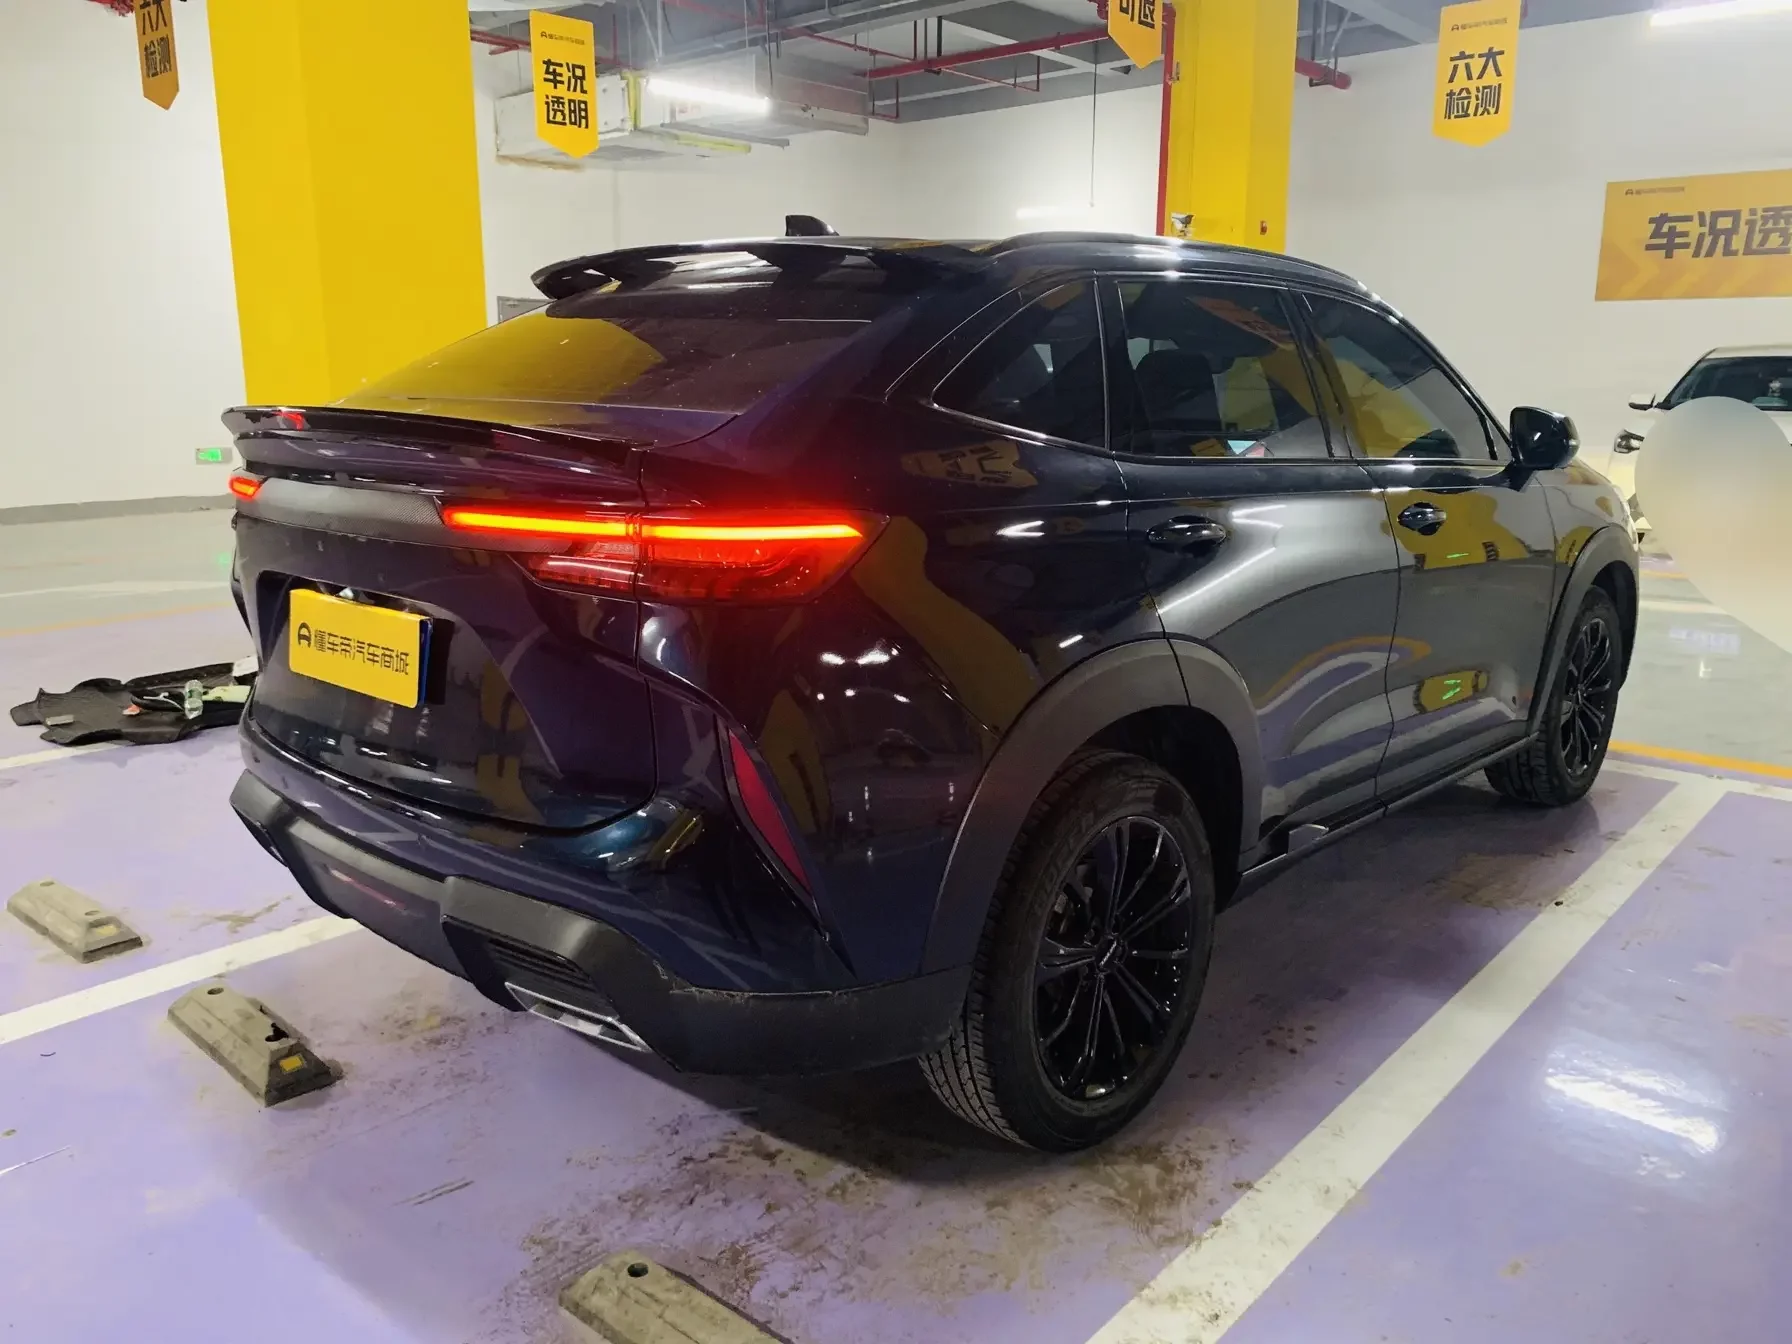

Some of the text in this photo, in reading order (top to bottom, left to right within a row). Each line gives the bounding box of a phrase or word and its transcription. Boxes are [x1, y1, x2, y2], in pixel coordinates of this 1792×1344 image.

[144, 34, 172, 78] 检测
[1447, 46, 1505, 83] 六大
[542, 58, 588, 94] 车况
[544, 94, 589, 129] 透明
[1444, 83, 1502, 119] 检测
[1645, 205, 1792, 259] 车况透
